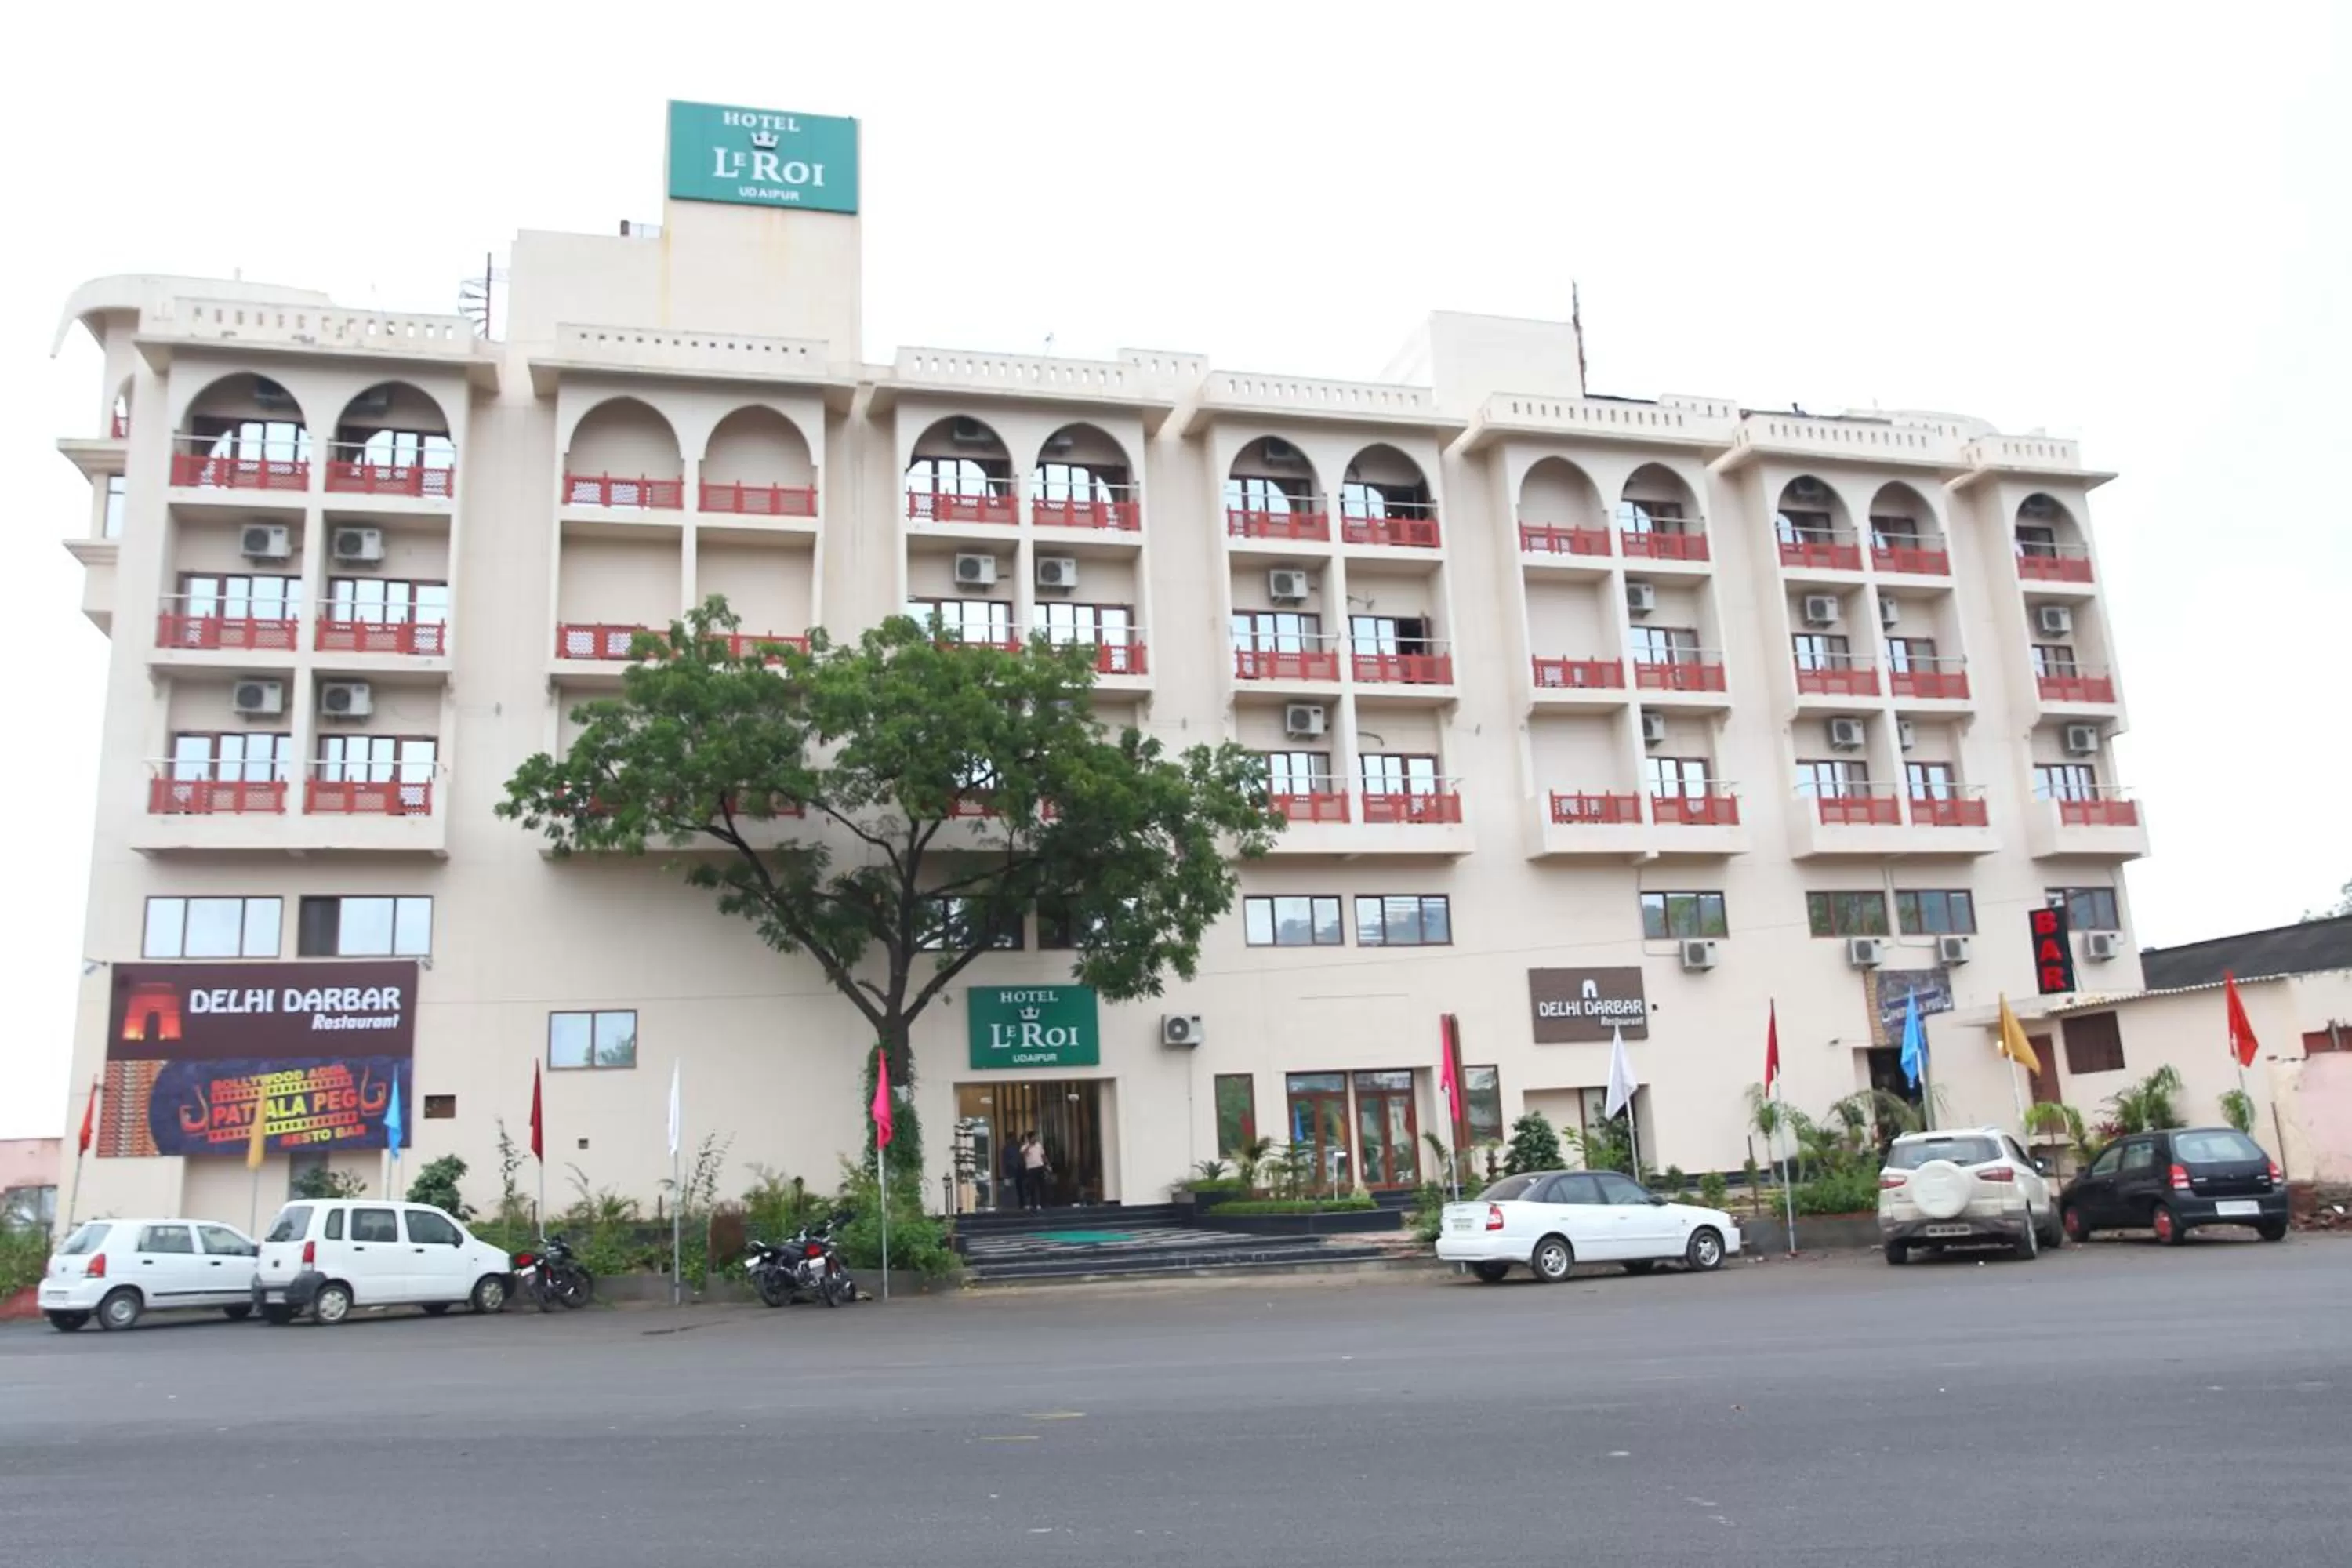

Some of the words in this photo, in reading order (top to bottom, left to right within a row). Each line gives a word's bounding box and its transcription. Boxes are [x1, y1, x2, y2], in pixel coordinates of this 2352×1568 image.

[723, 111, 800, 132] HOTEL
[738, 185, 800, 201] UDAIPUR
[2034, 910, 2066, 991] BAR
[189, 989, 274, 1013] DELHI
[282, 987, 401, 1011] DARBAR
[1000, 990, 1059, 1004] HOTEL
[1539, 1001, 1581, 1017] DELHI
[1584, 1000, 1643, 1015] DARBAR
[312, 1014, 400, 1031] Restaurant
[1012, 1053, 1058, 1063] UDAIPUR
[212, 1094, 307, 1127] PATALA
[313, 1088, 358, 1112] PEG
